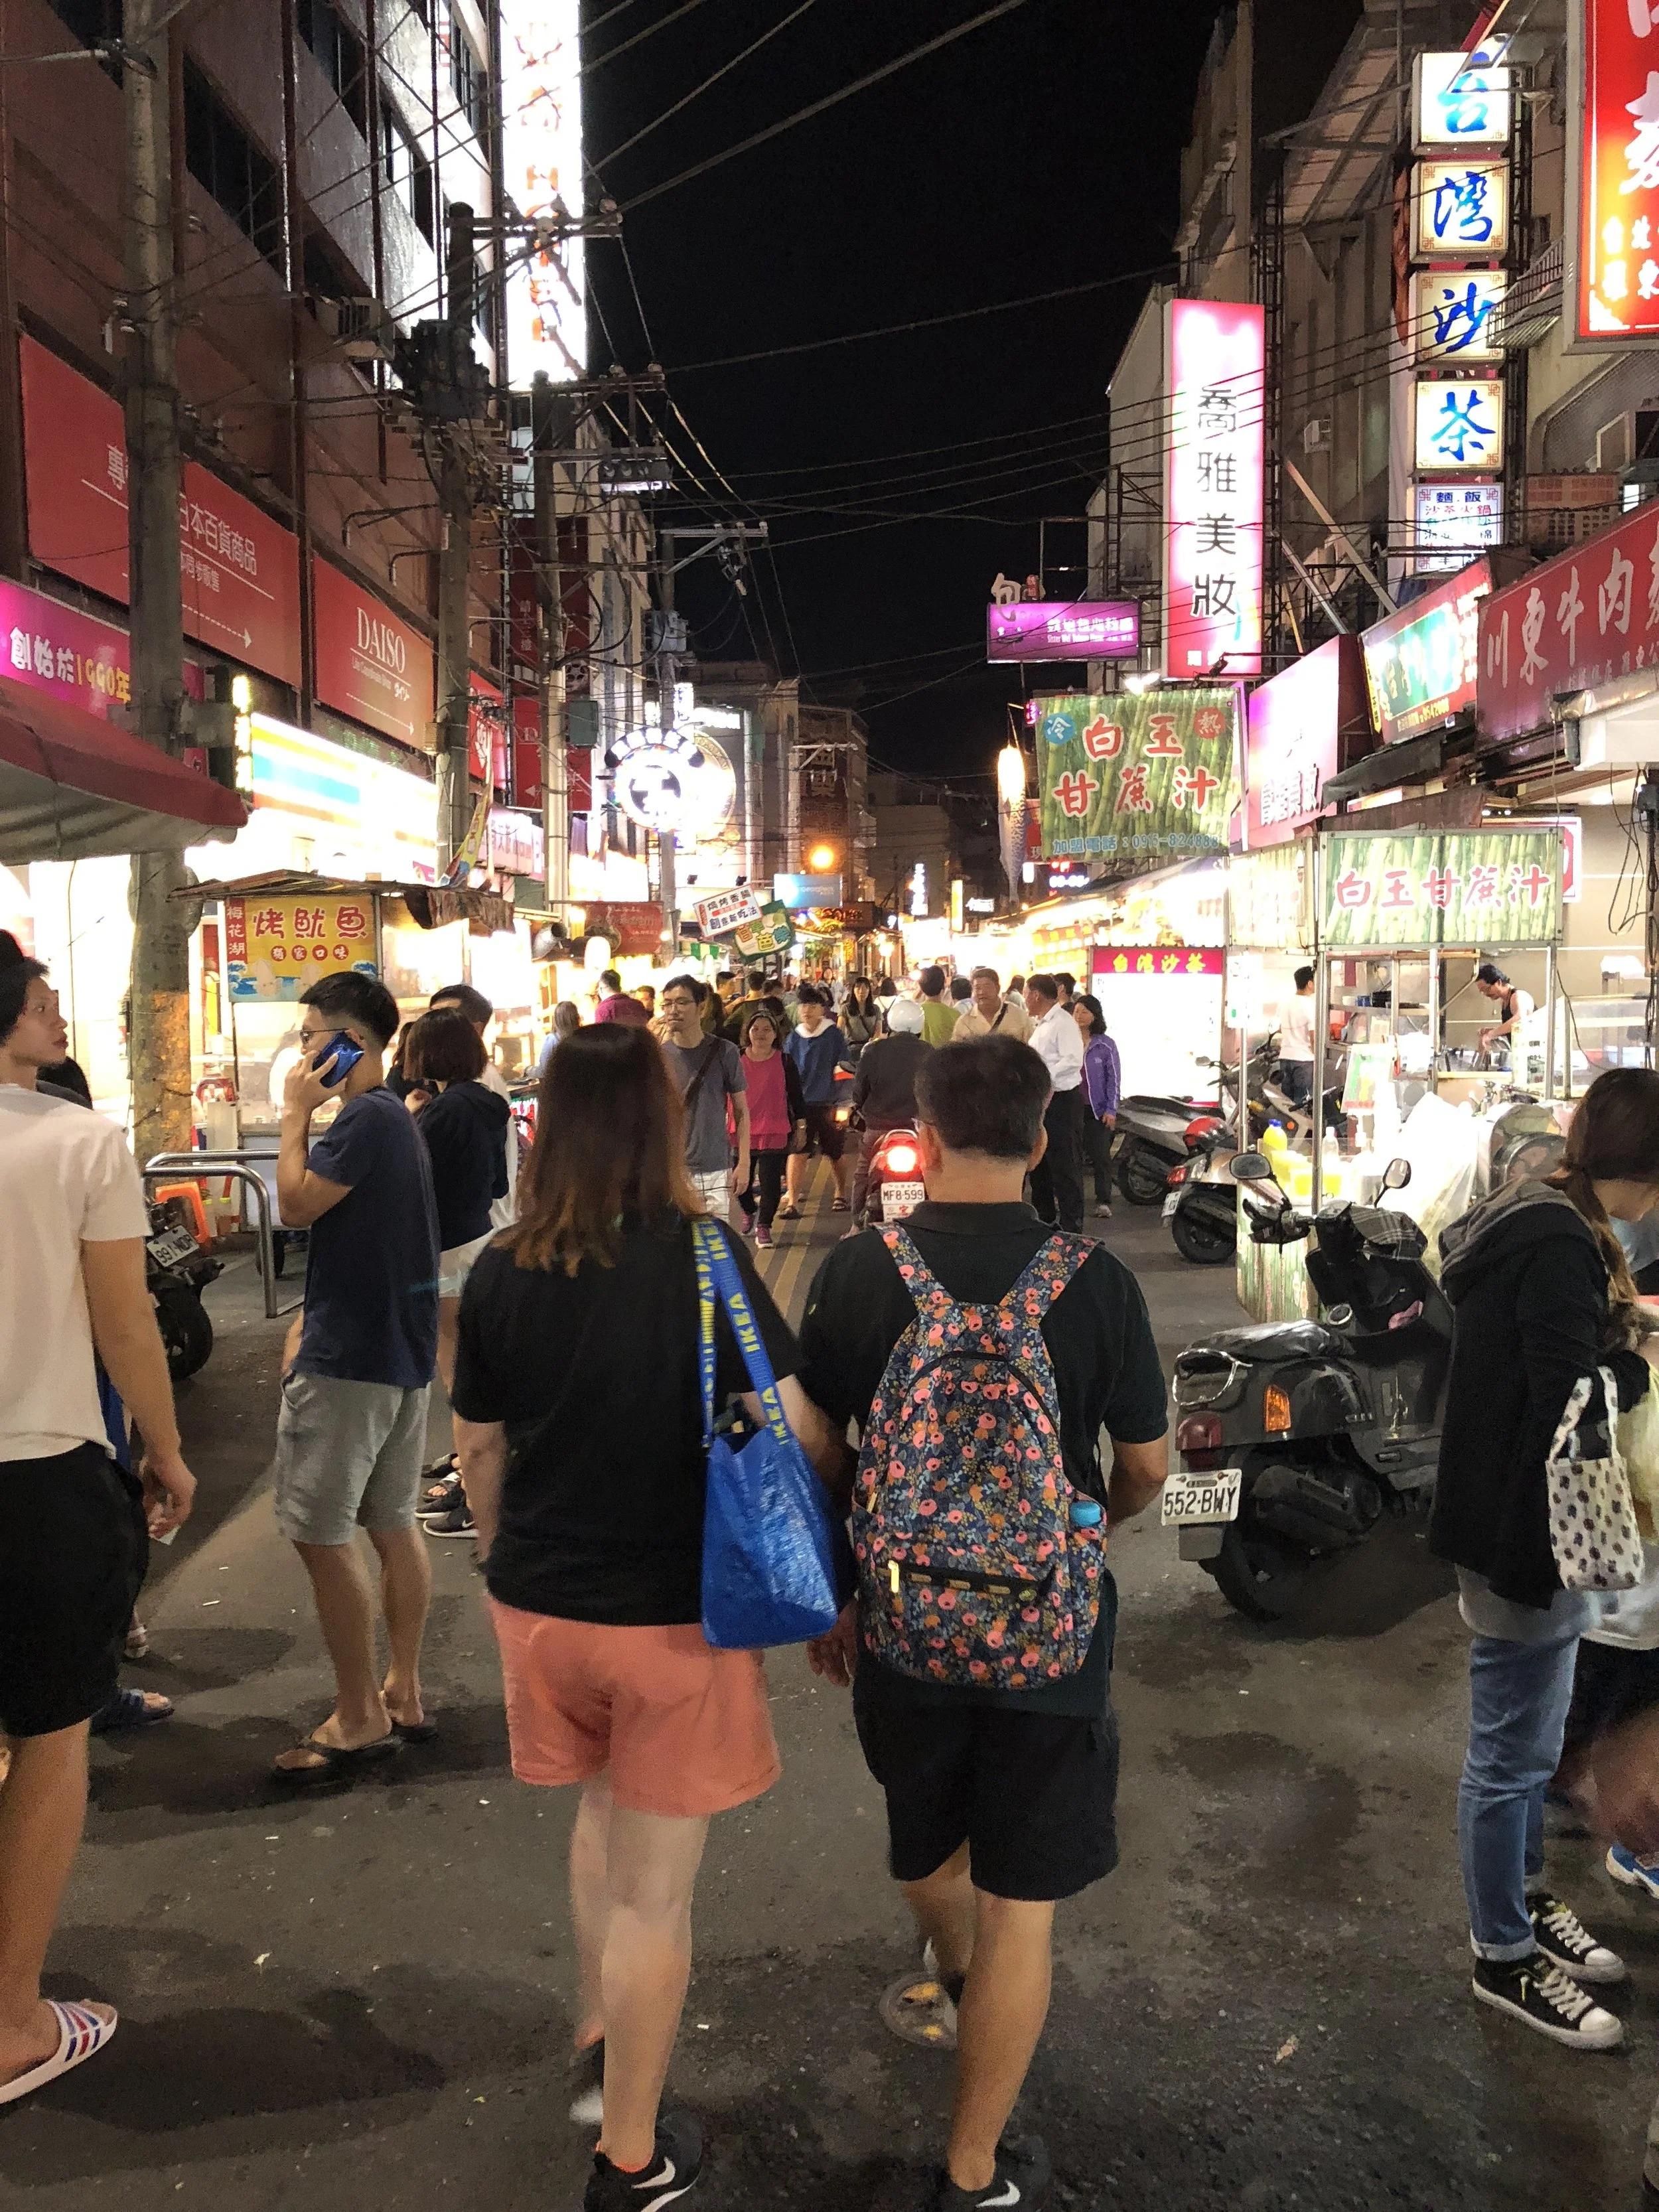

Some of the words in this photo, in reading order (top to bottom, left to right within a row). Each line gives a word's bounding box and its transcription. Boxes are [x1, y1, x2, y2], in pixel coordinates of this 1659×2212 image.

[1194, 387, 1237, 616] 喬雅美妝
[1487, 520, 1659, 689] 川東牛肉
[357, 607, 405, 674] DAISO
[1047, 717, 1071, 740] 冷
[1084, 715, 1184, 759] 白玉
[1197, 711, 1222, 735] 熱
[1054, 765, 1218, 815] 甘蔗汁
[1336, 866, 1550, 909] 白玉甘蔗汁
[227, 907, 246, 956] 梅花湖
[252, 906, 367, 939] 烤魷魚
[1113, 952, 1206, 974] 台灣沙茶
[883, 1189, 923, 1201] MF8-599
[729, 1292, 761, 1353] IKEA
[762, 1386, 790, 1446] IKEA
